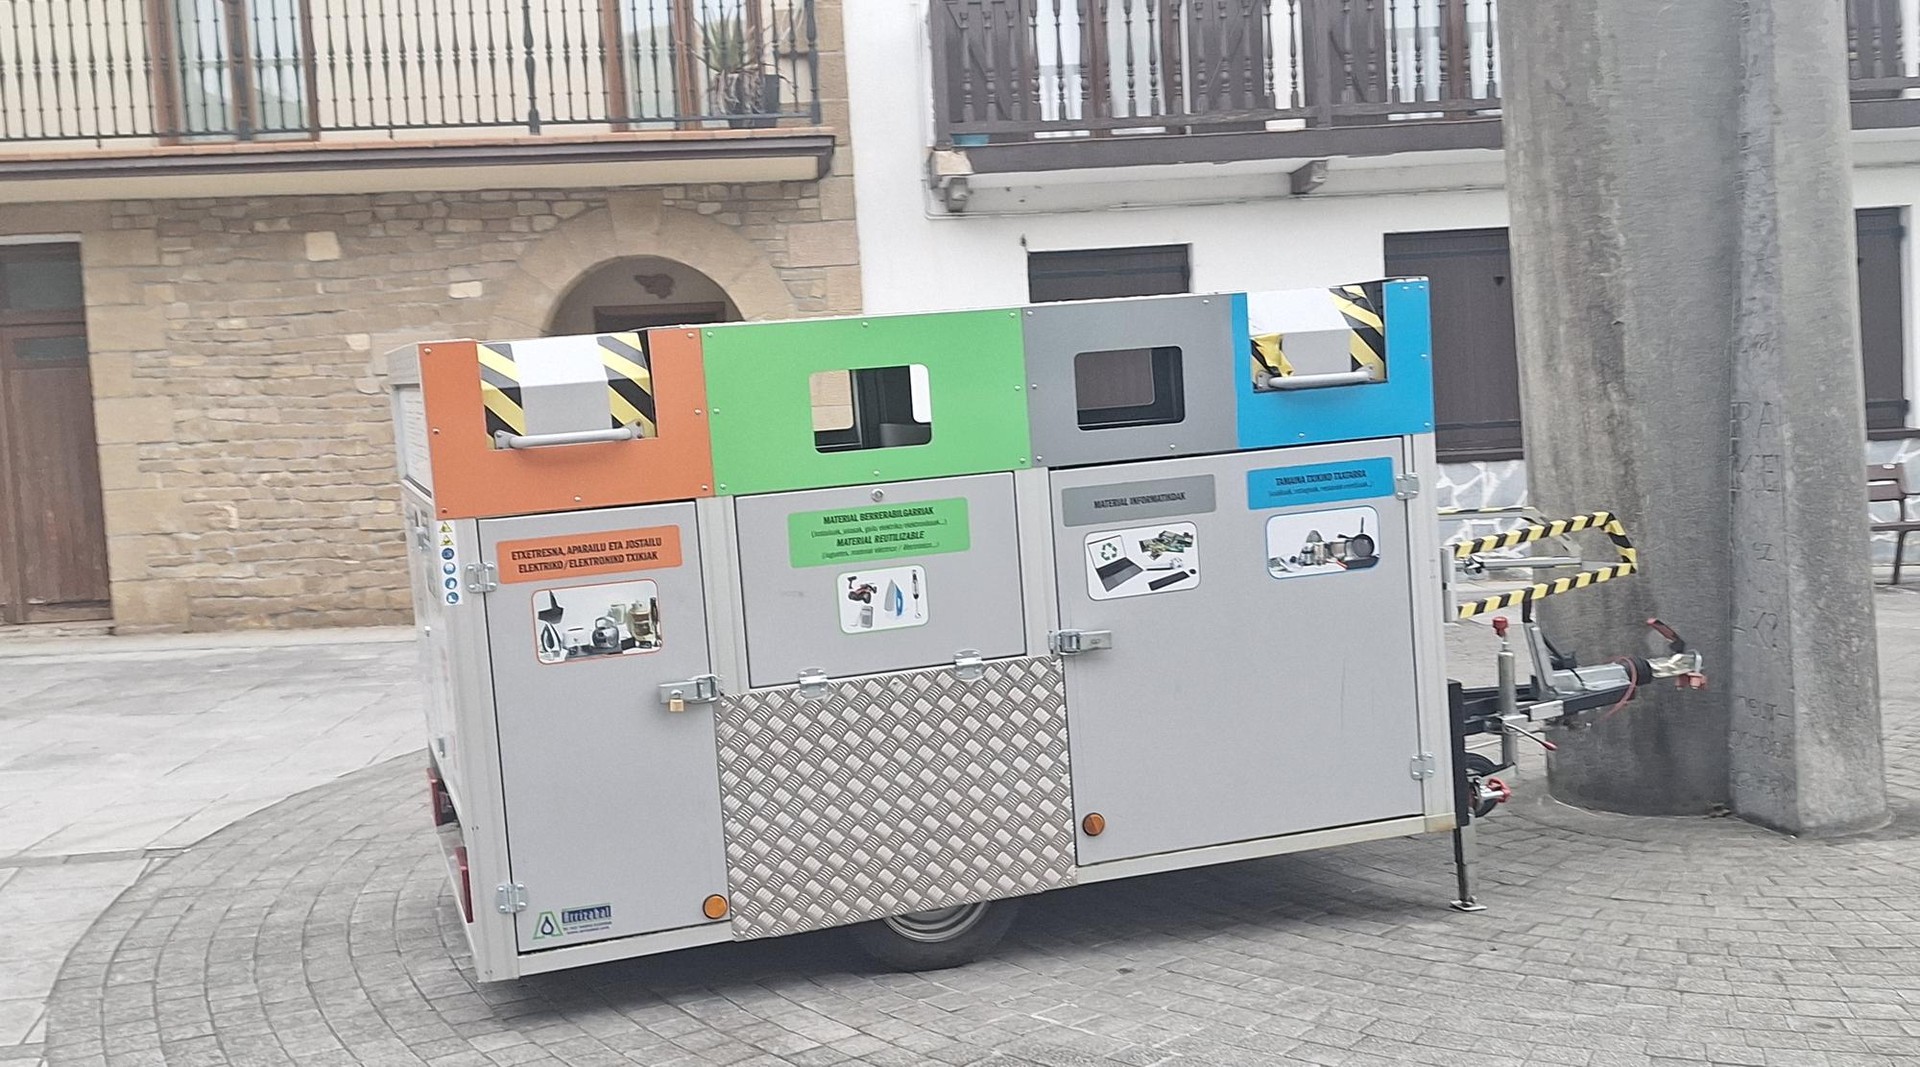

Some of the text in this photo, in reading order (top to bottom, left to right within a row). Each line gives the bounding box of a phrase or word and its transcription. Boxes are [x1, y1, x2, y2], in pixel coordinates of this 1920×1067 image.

[1094, 498, 1128, 507] MATERIAL
[823, 507, 935, 524] MATERIAL BERRERABILGARRIAK
[837, 531, 925, 546] MATERIAL REUTILIZABLE
[511, 538, 662, 561] ETXETRESNA, APARAILU ETA JOSTAILU
[519, 561, 563, 572] ELEKTRIKO
[569, 555, 624, 567] ELEKTRONIKO
[626, 552, 659, 562] TXIKIAK
